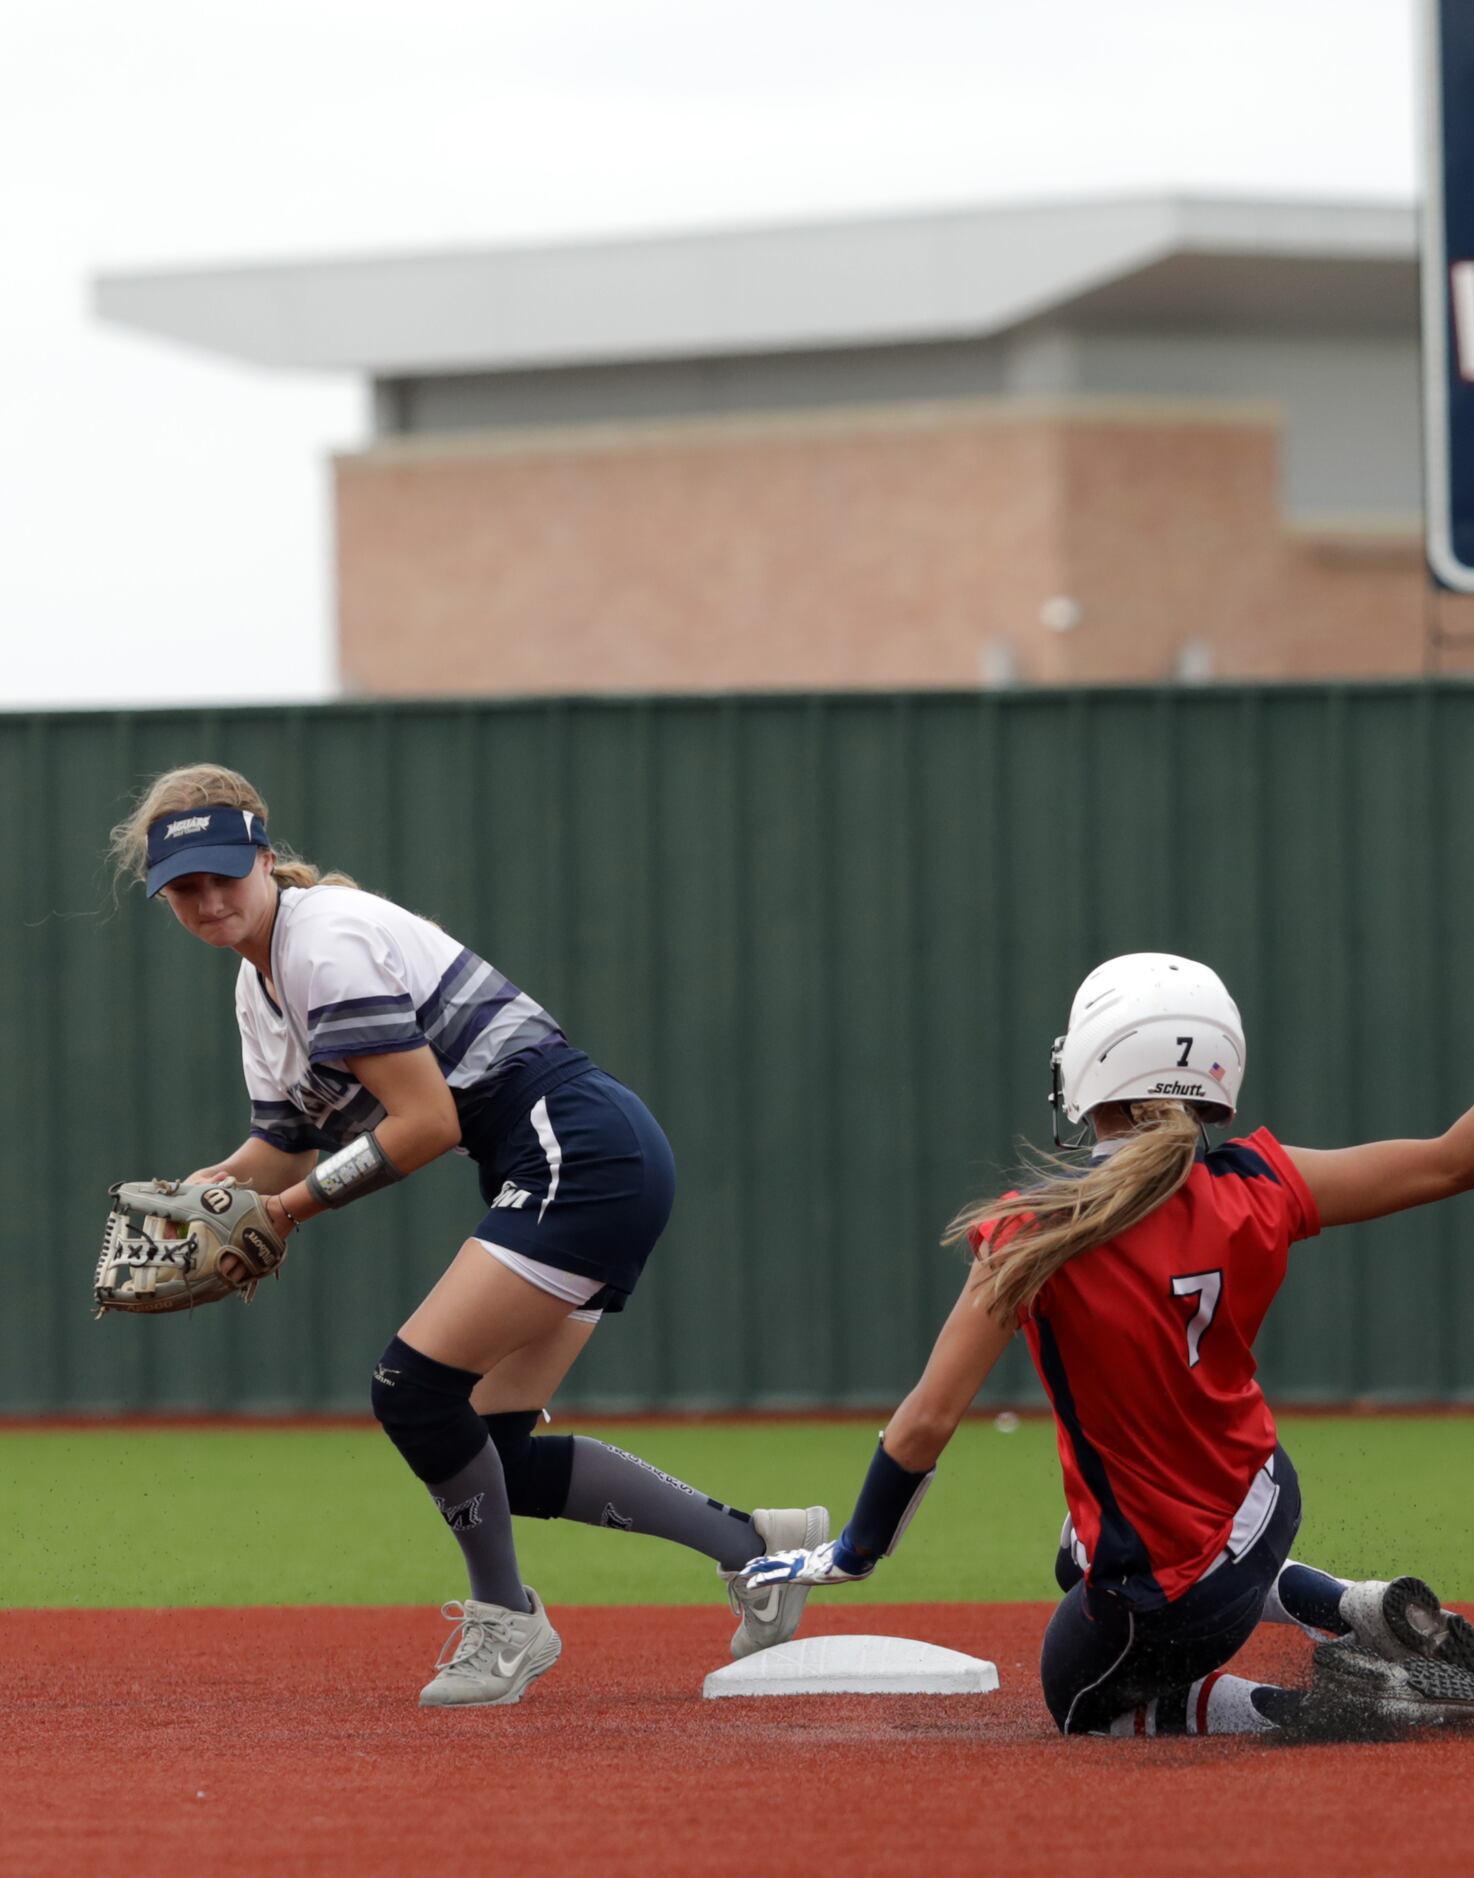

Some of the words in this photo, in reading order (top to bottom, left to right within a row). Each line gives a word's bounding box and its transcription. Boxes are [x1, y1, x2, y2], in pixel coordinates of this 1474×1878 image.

[1177, 1037, 1193, 1067] 7
[1154, 1080, 1203, 1097] schutt
[1170, 1269, 1223, 1369] 7
